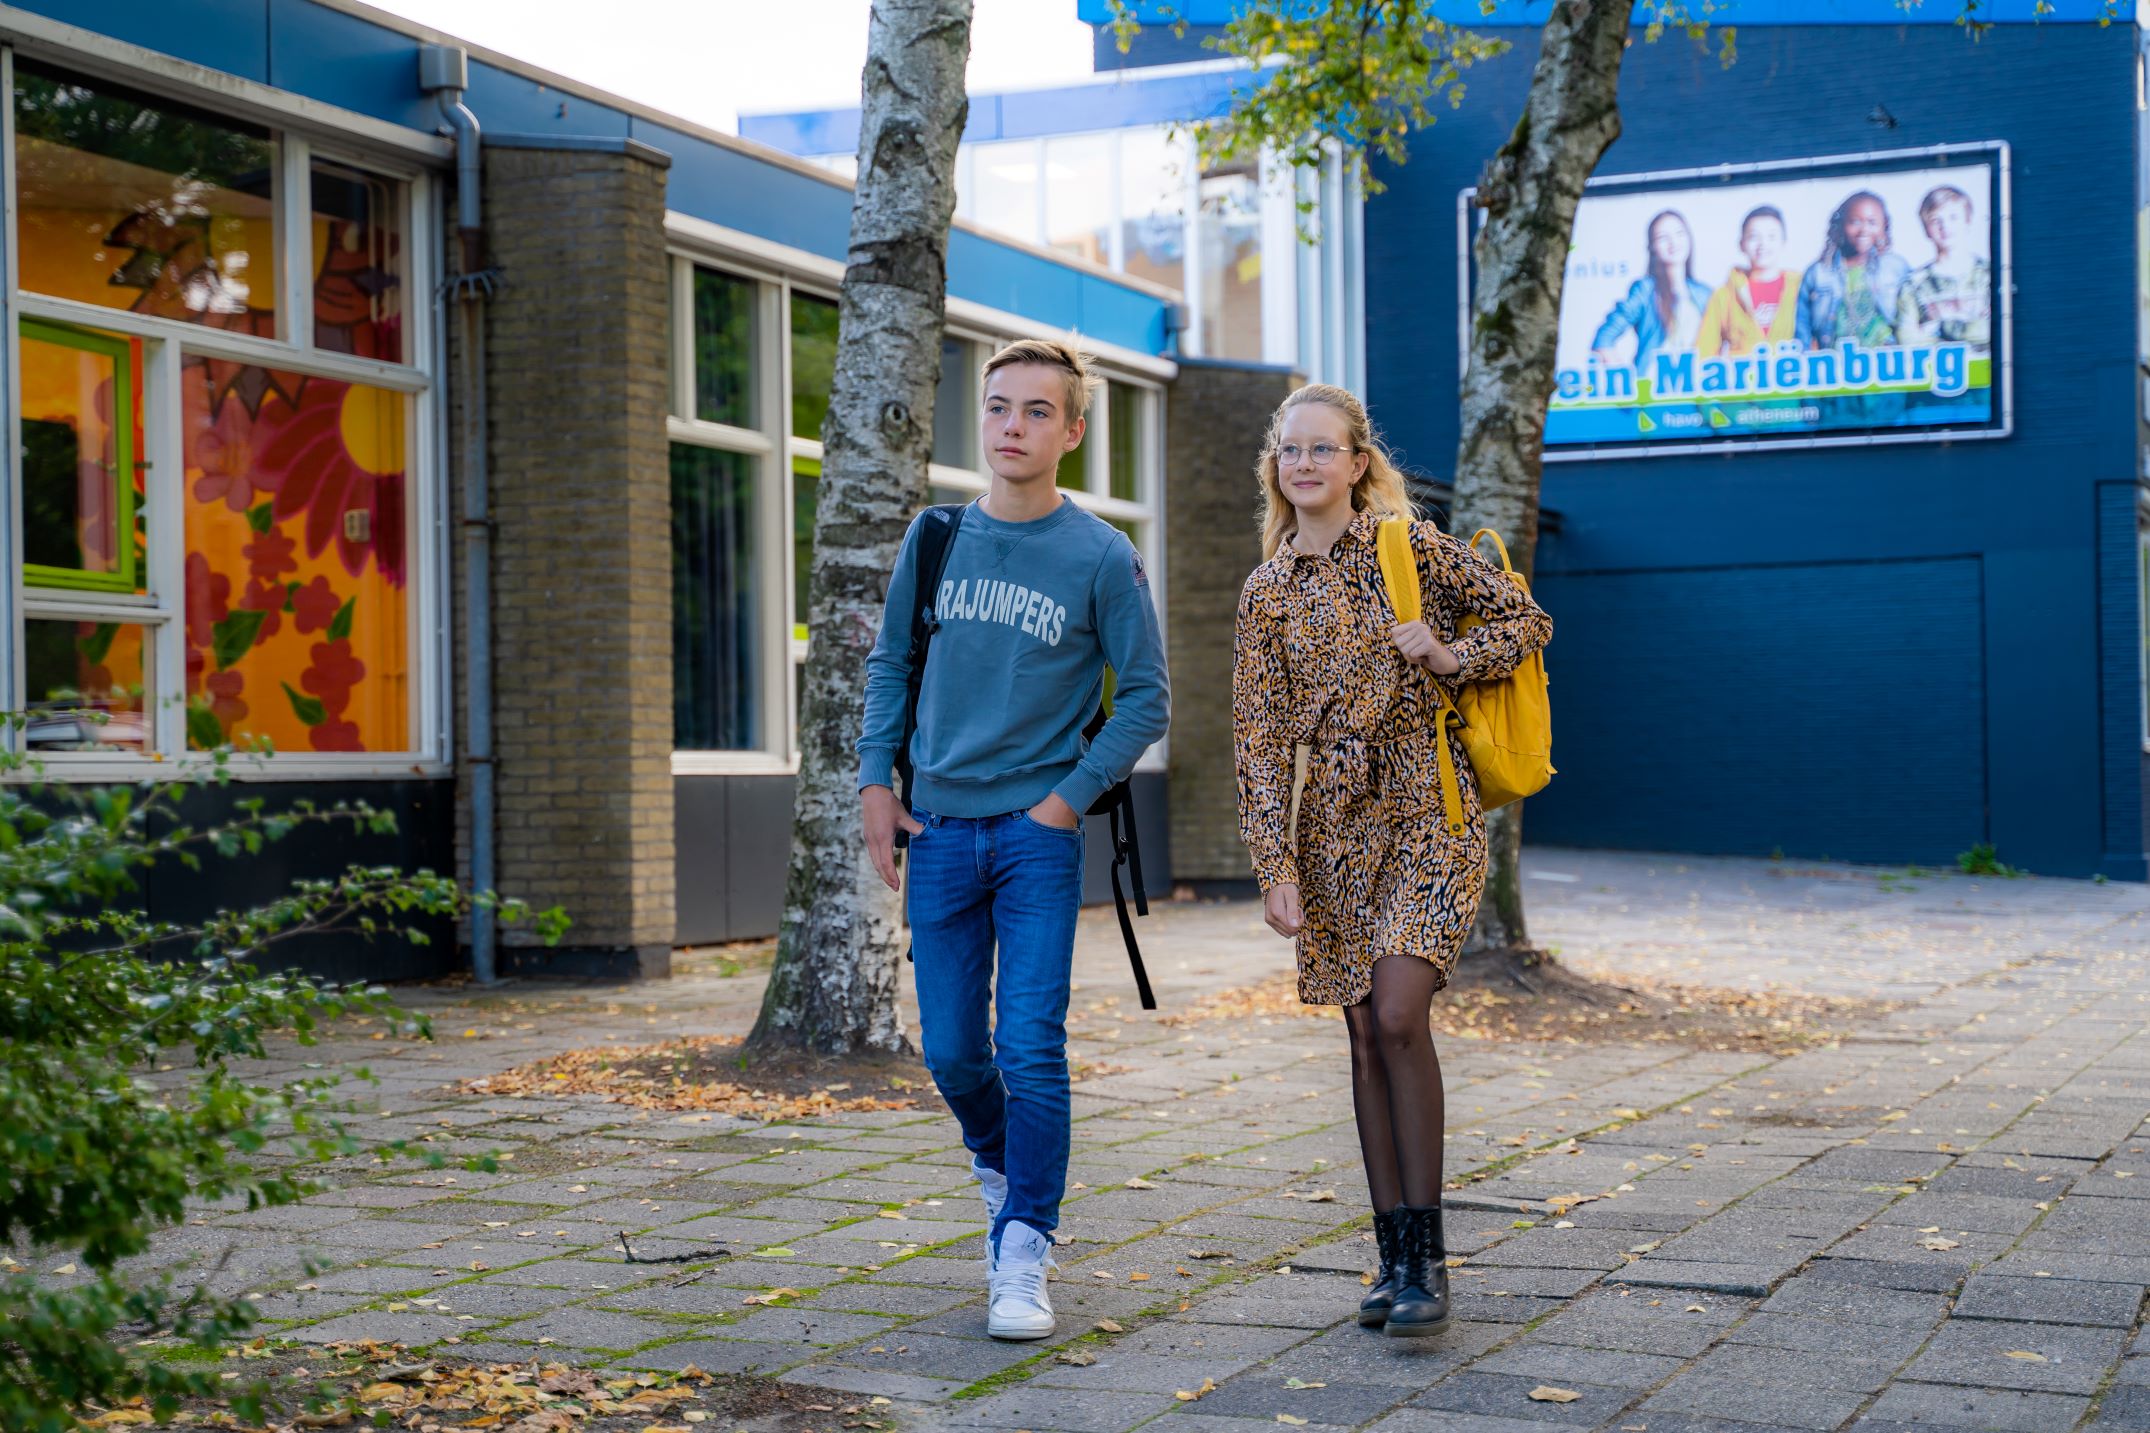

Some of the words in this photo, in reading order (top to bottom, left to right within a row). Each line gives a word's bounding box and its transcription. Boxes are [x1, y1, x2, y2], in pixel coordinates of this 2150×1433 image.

[1565, 256, 1628, 278] nius
[1554, 358, 1632, 399] ein
[1656, 342, 1965, 391] Mariënburg
[1662, 410, 1703, 428] havo
[1736, 406, 1819, 425] atheneum
[935, 579, 1066, 647] RAJUMPERS
